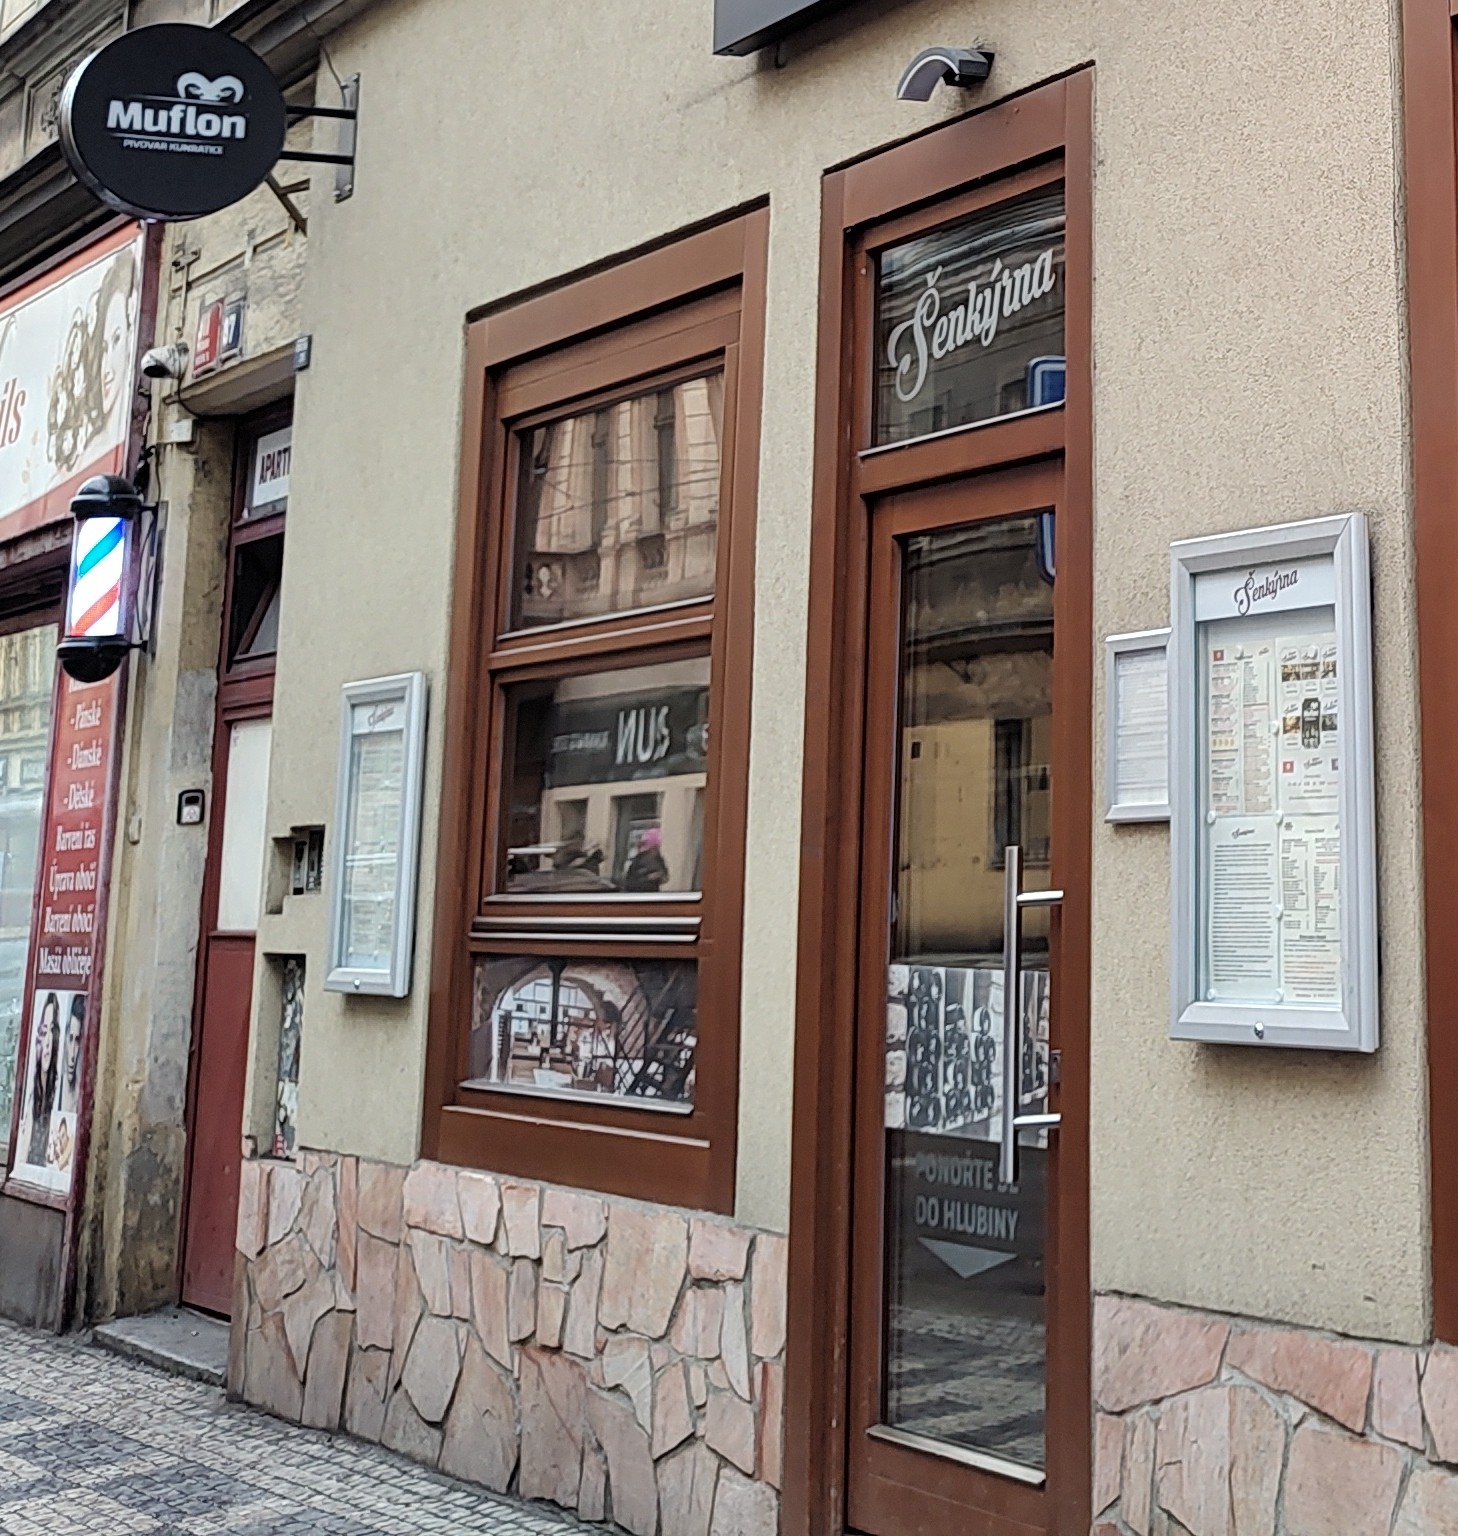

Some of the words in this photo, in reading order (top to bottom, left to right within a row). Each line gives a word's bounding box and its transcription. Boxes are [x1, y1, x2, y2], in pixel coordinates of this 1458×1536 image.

[106, 99, 247, 140] Muflon
[122, 138, 168, 151] PIVOVAR
[887, 248, 1056, 403] Šenkýrna
[1233, 568, 1299, 617] Šenkýrna
[915, 1195, 940, 1227] DO
[942, 1198, 1019, 1242] HLUBINY
